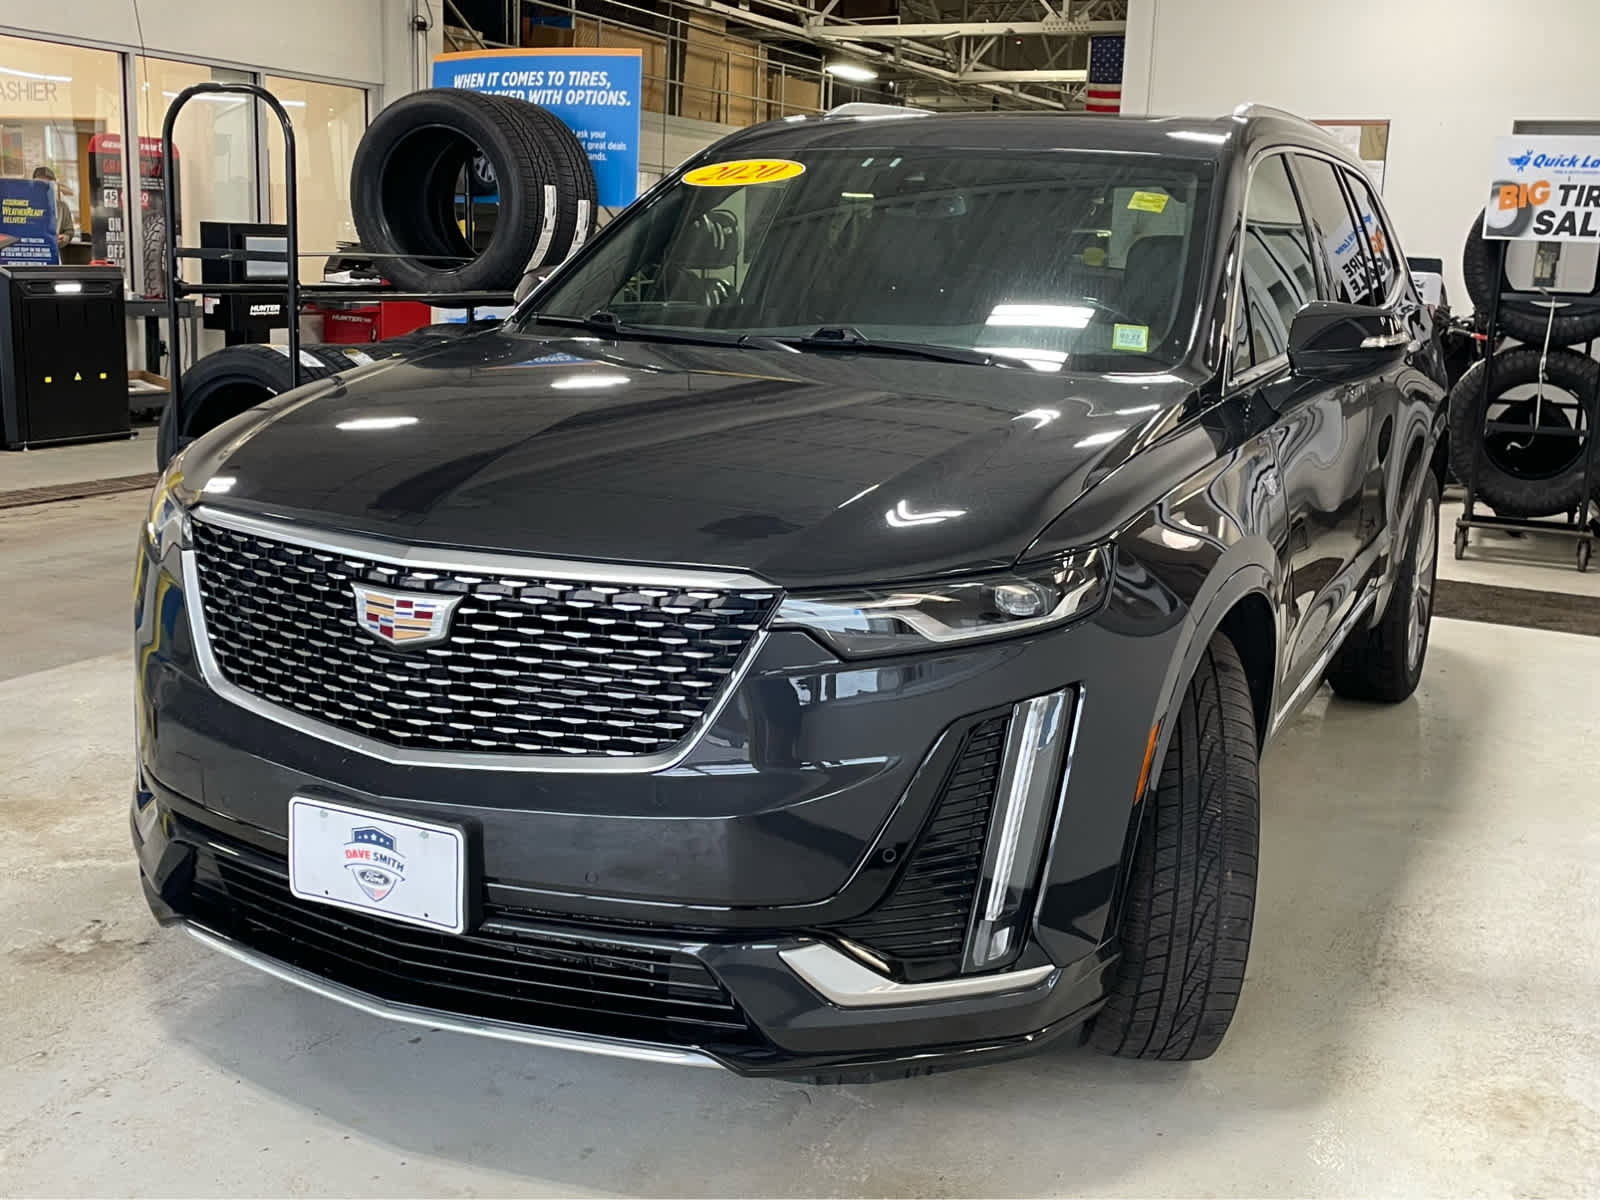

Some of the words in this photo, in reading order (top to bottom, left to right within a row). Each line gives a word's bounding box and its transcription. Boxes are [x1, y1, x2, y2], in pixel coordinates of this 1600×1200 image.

[454, 74, 485, 89] WHEN
[487, 72, 499, 87] IT
[501, 71, 544, 87] COMES
[547, 71, 565, 86] TO
[568, 71, 611, 90] TIRES,
[528, 90, 561, 105] WITH
[565, 90, 631, 107] OPTIONS.
[576, 129, 588, 139] ask
[590, 131, 606, 140] your
[587, 141, 606, 151] great
[607, 141, 627, 151] deals
[1533, 153, 1580, 168] Quick
[696, 164, 790, 181] 2020
[1498, 180, 1551, 211] BIG
[1532, 210, 1600, 237] SAL
[107, 244, 124, 258] OFF
[250, 304, 280, 312] HUNTER
[345, 849, 371, 861] DAVE
[373, 852, 404, 872] SMITH
